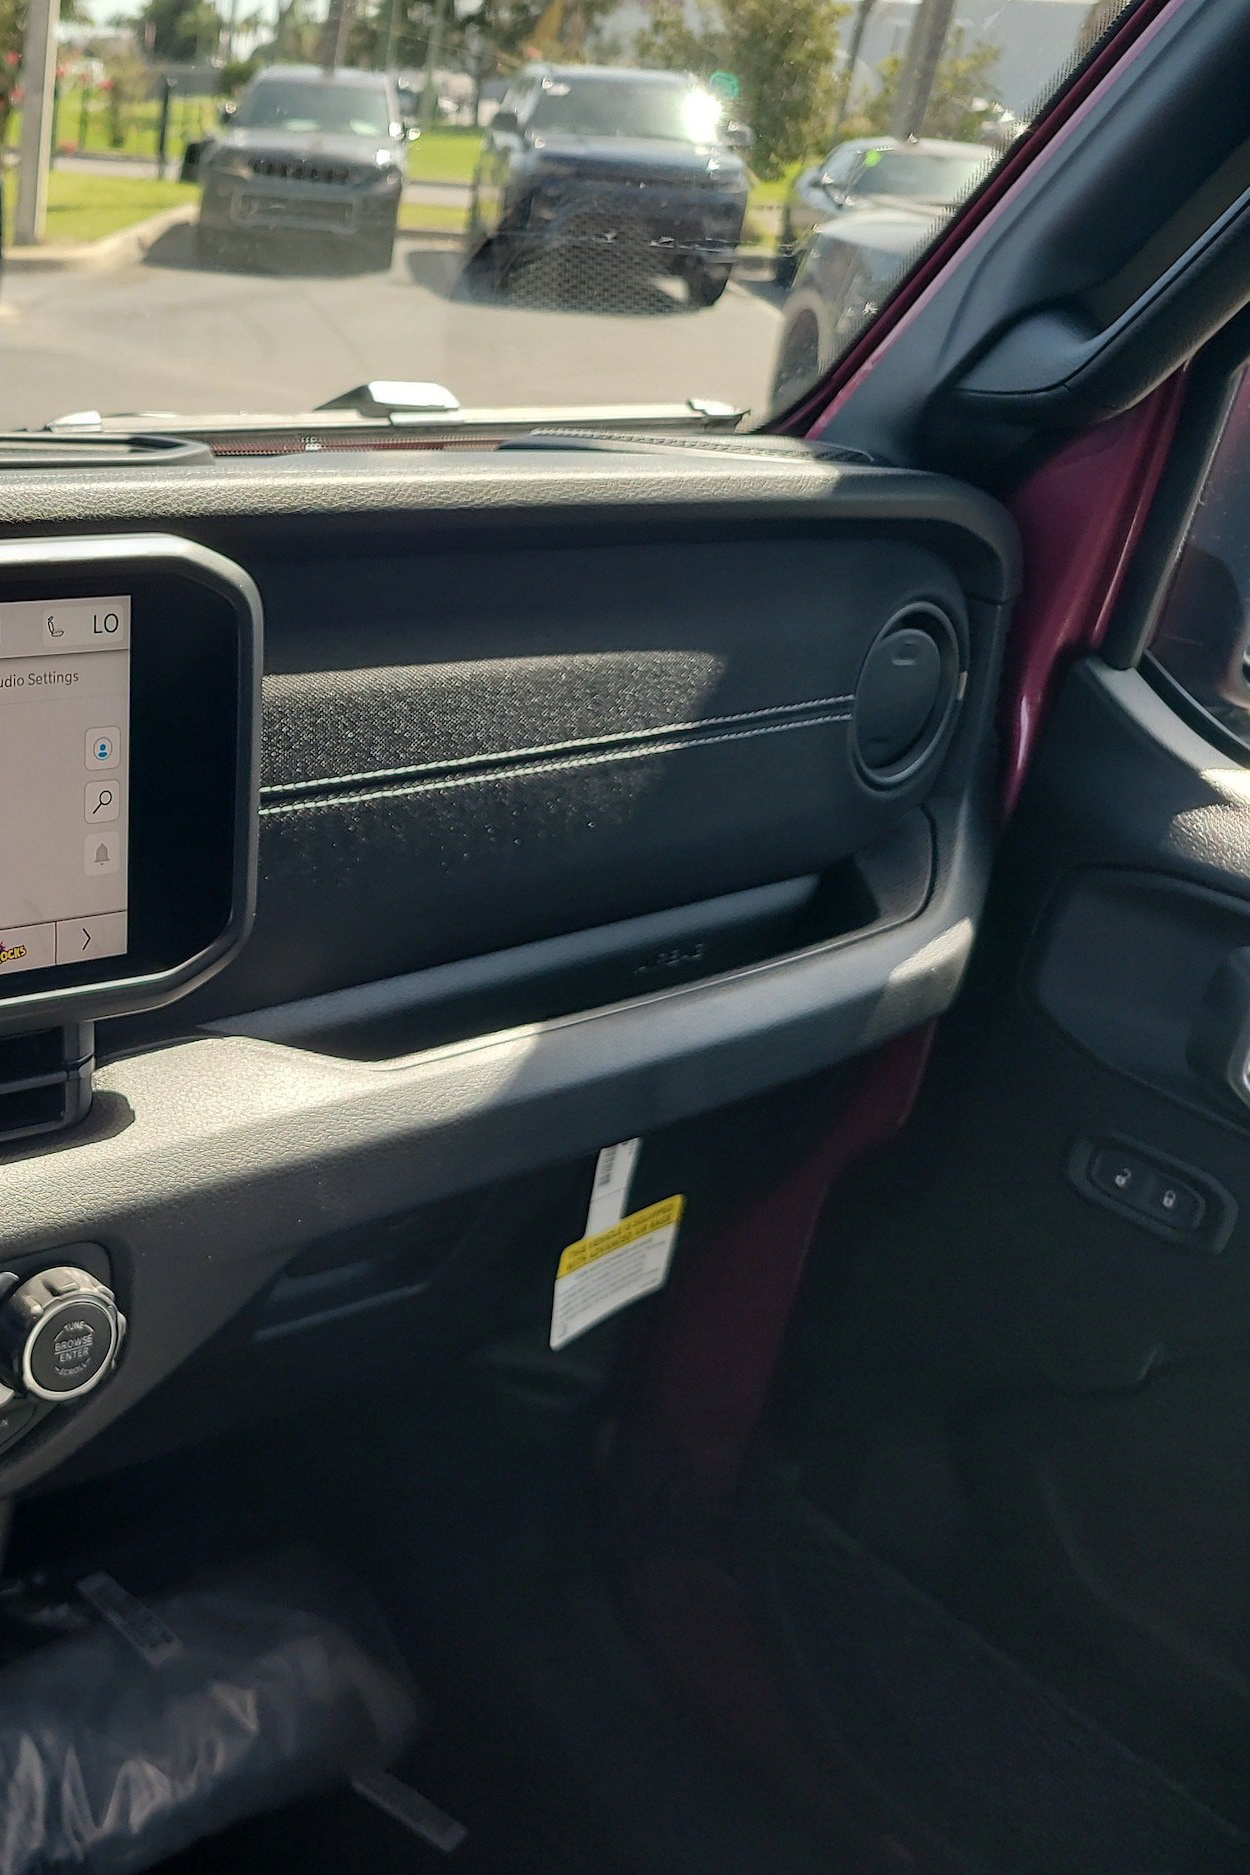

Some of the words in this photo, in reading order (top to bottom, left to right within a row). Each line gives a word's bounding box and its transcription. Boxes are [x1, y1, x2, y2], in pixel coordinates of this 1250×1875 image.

[93, 613, 119, 635] LO
[27, 670, 80, 688] Settings
[63, 1320, 85, 1332] TUNE
[54, 1333, 93, 1351] BROWSE
[59, 1347, 89, 1362] ENTER
